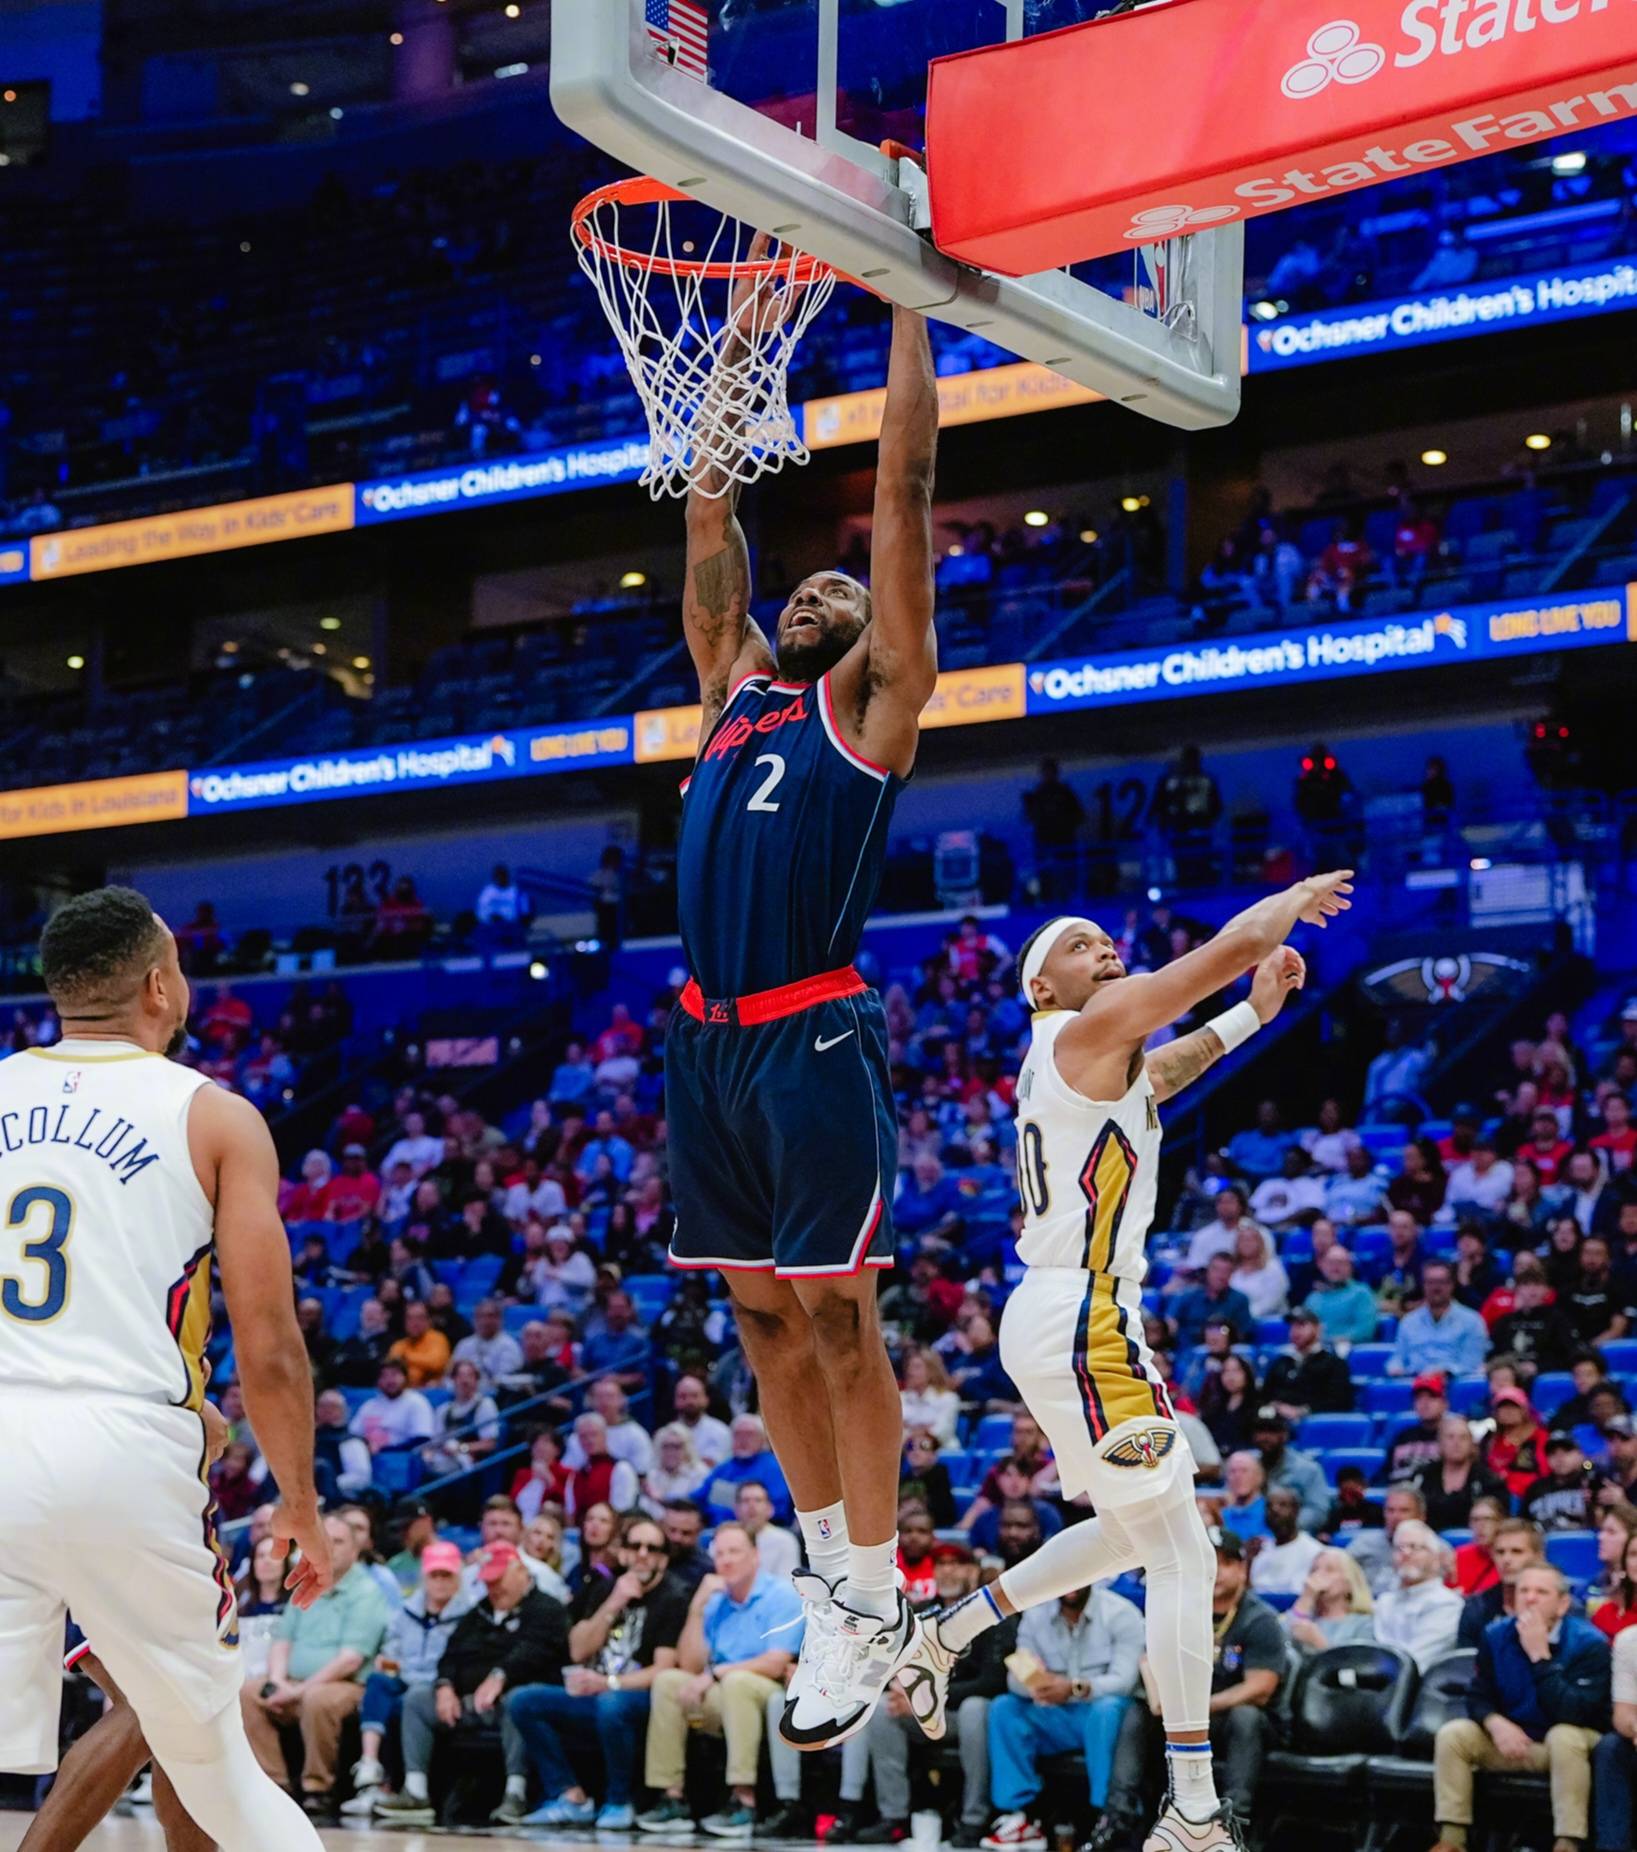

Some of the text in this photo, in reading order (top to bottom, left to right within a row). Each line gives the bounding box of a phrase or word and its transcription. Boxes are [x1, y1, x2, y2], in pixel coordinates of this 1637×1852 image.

[1271, 265, 1637, 356] Ochsner Children's Hospit
[566, 442, 652, 480] Hospita
[1043, 620, 1435, 699] Ochsner Children's Hospital
[396, 740, 492, 779] Hospital
[746, 753, 786, 812] 2
[2, 1184, 75, 1326] 3
